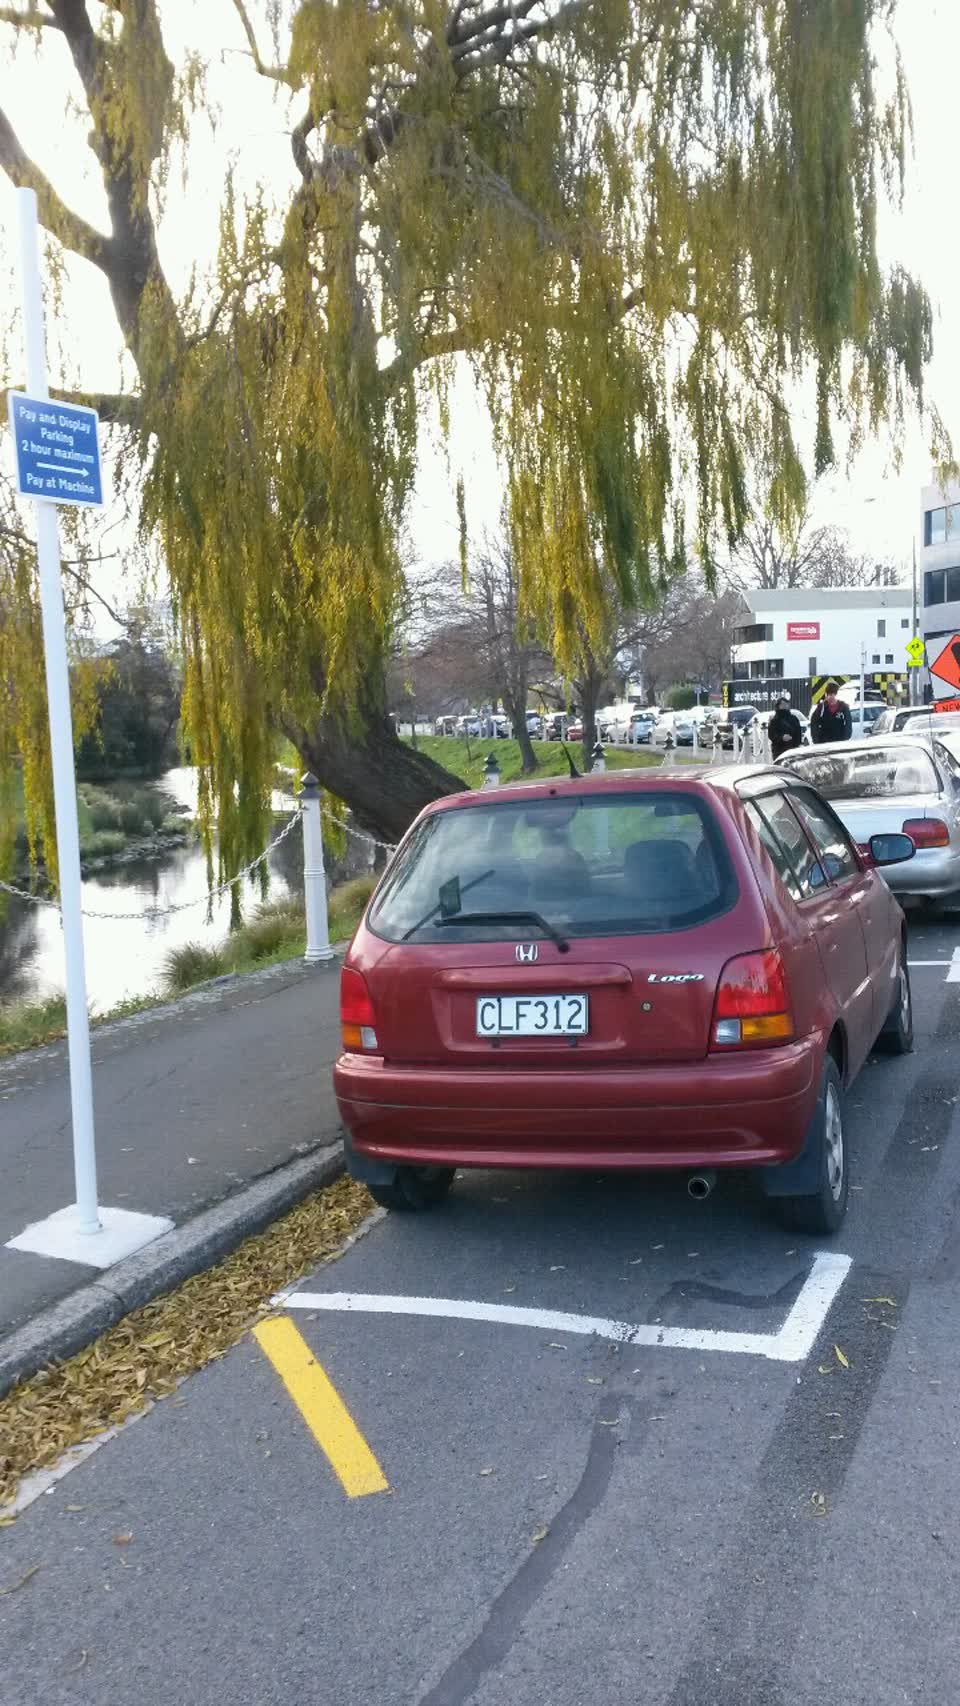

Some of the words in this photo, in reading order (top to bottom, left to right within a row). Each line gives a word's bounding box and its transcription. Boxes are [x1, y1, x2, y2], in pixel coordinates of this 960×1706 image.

[19, 406, 36, 422] Pay
[39, 413, 56, 425] and
[59, 415, 91, 434] Display
[40, 427, 74, 446] Parking
[22, 439, 29, 452] 2
[30, 441, 51, 455] hour
[54, 448, 94, 464] maximum
[26, 472, 43, 488] Pay
[46, 477, 56, 489] at
[58, 478, 95, 495] Machine
[647, 973, 704, 984] Logo
[480, 999, 582, 1031] CLF312
